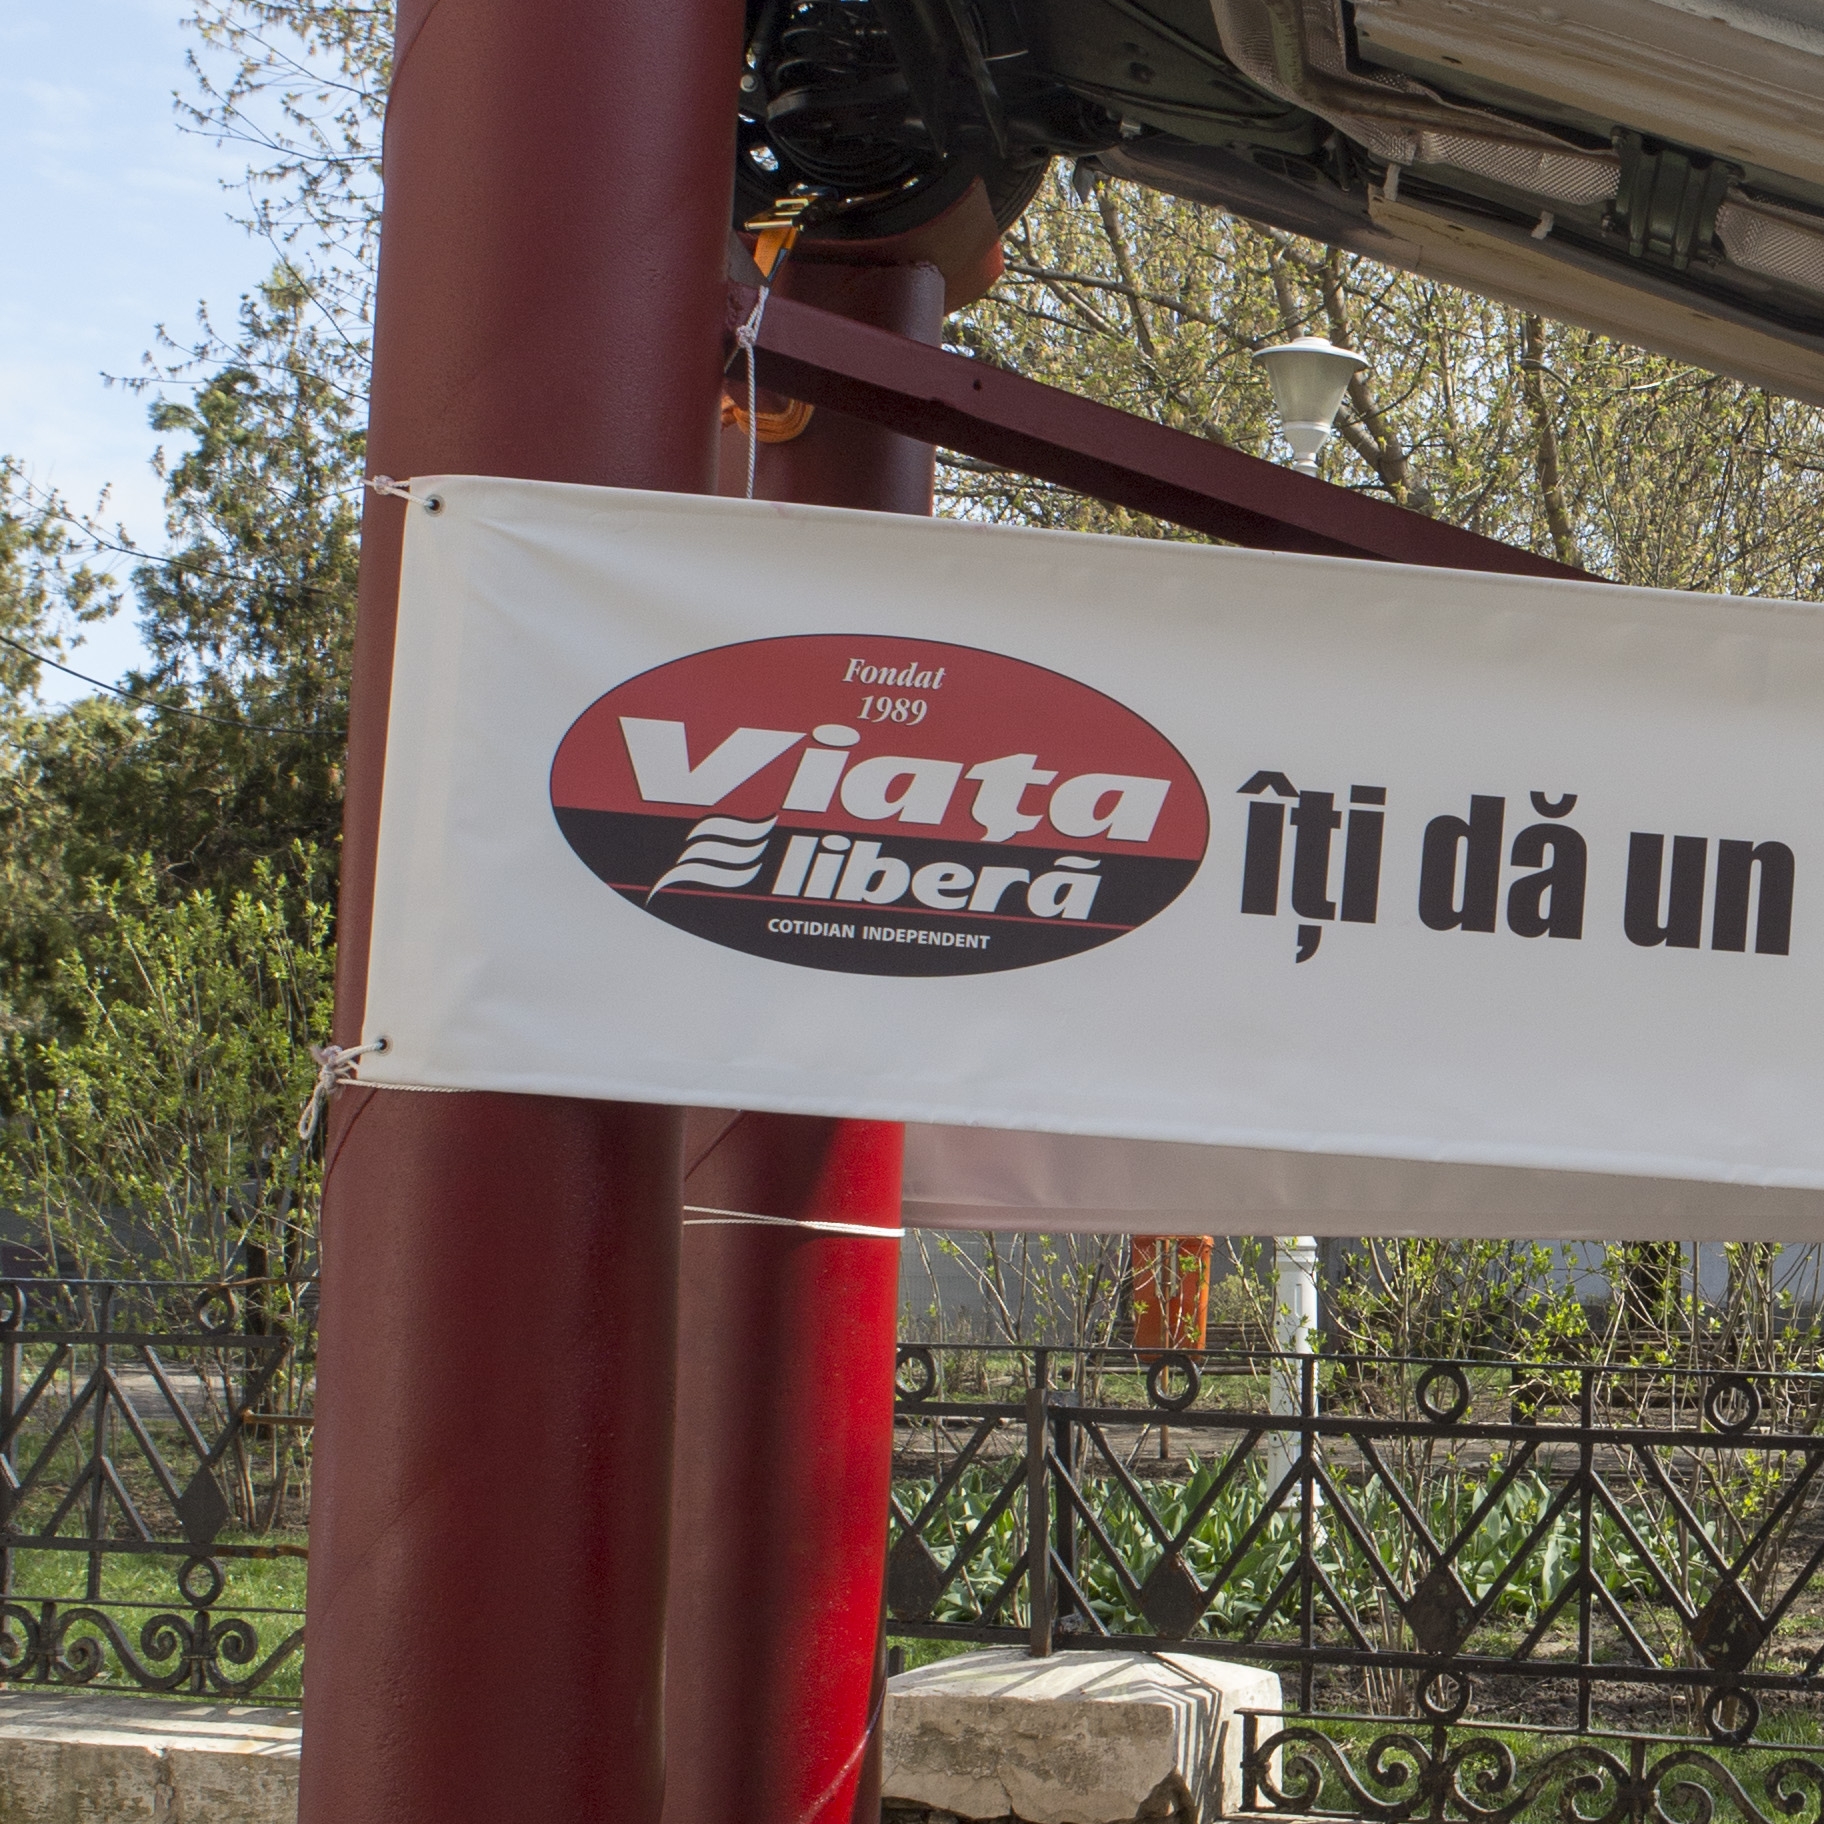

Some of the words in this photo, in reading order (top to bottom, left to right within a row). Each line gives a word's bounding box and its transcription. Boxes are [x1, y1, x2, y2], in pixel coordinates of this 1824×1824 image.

[842, 657, 947, 691] Fondat
[856, 694, 930, 726] 1989
[1418, 791, 1588, 940] dă
[1623, 831, 1796, 957] un
[767, 917, 856, 940] COTIDIAN
[862, 925, 991, 951] INDEPENDENT
